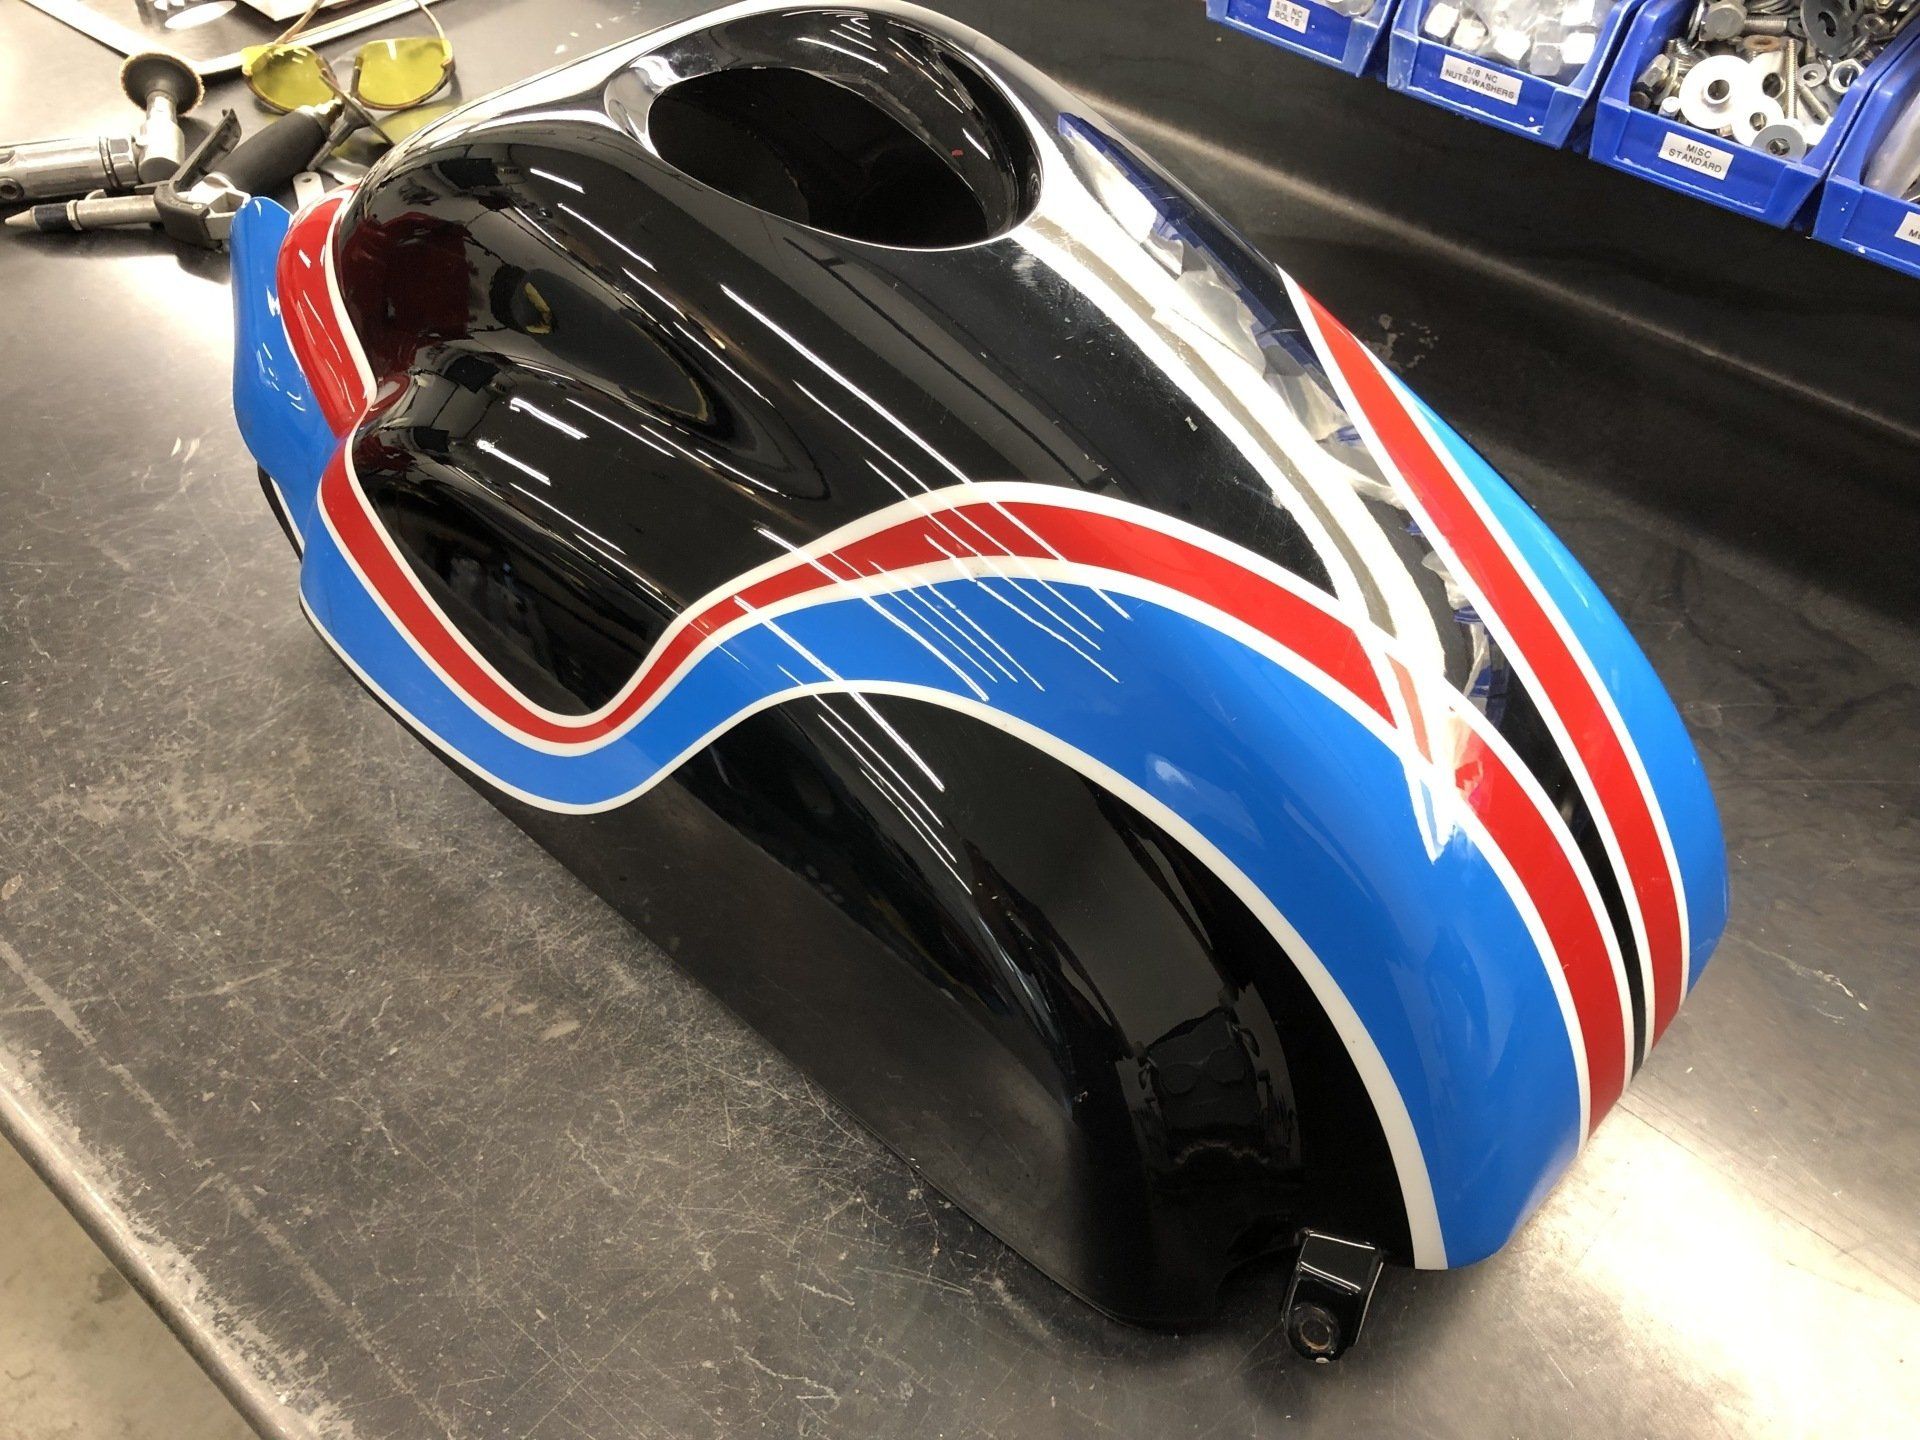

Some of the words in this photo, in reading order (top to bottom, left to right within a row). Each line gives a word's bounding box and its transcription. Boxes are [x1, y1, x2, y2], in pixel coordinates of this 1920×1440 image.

[1275, 10, 1300, 26] BOLTS
[1466, 66, 1480, 78] 5/8
[1485, 73, 1498, 83] NC
[1445, 69, 1515, 99] NUTS/WASHERS
[1686, 144, 1712, 159] MISC
[1668, 148, 1722, 173] STANDARD
